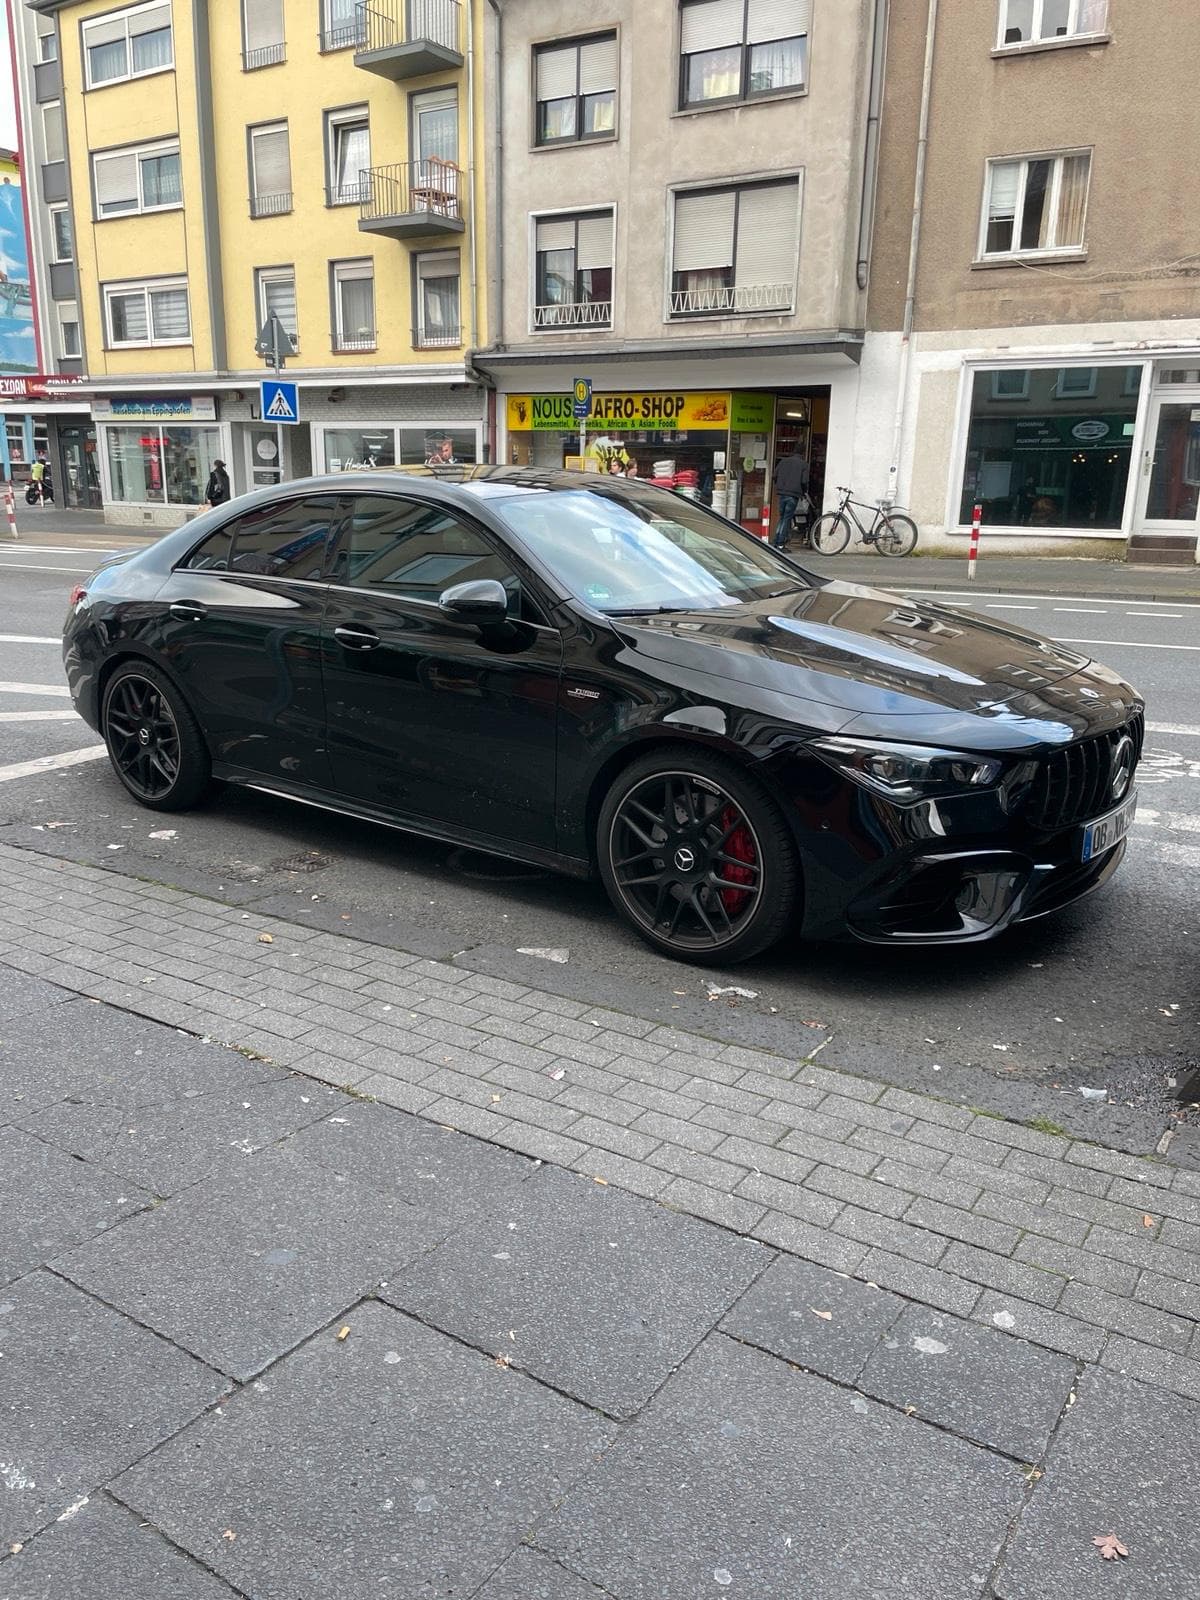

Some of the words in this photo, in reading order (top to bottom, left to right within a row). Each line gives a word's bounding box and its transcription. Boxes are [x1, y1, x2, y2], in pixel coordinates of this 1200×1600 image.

[532, 398, 572, 418] NOUS
[594, 397, 684, 418] AFRO-SHOP
[607, 419, 627, 428] African
[631, 420, 635, 428] &
[639, 419, 655, 428] Asian
[658, 419, 676, 427] Foods
